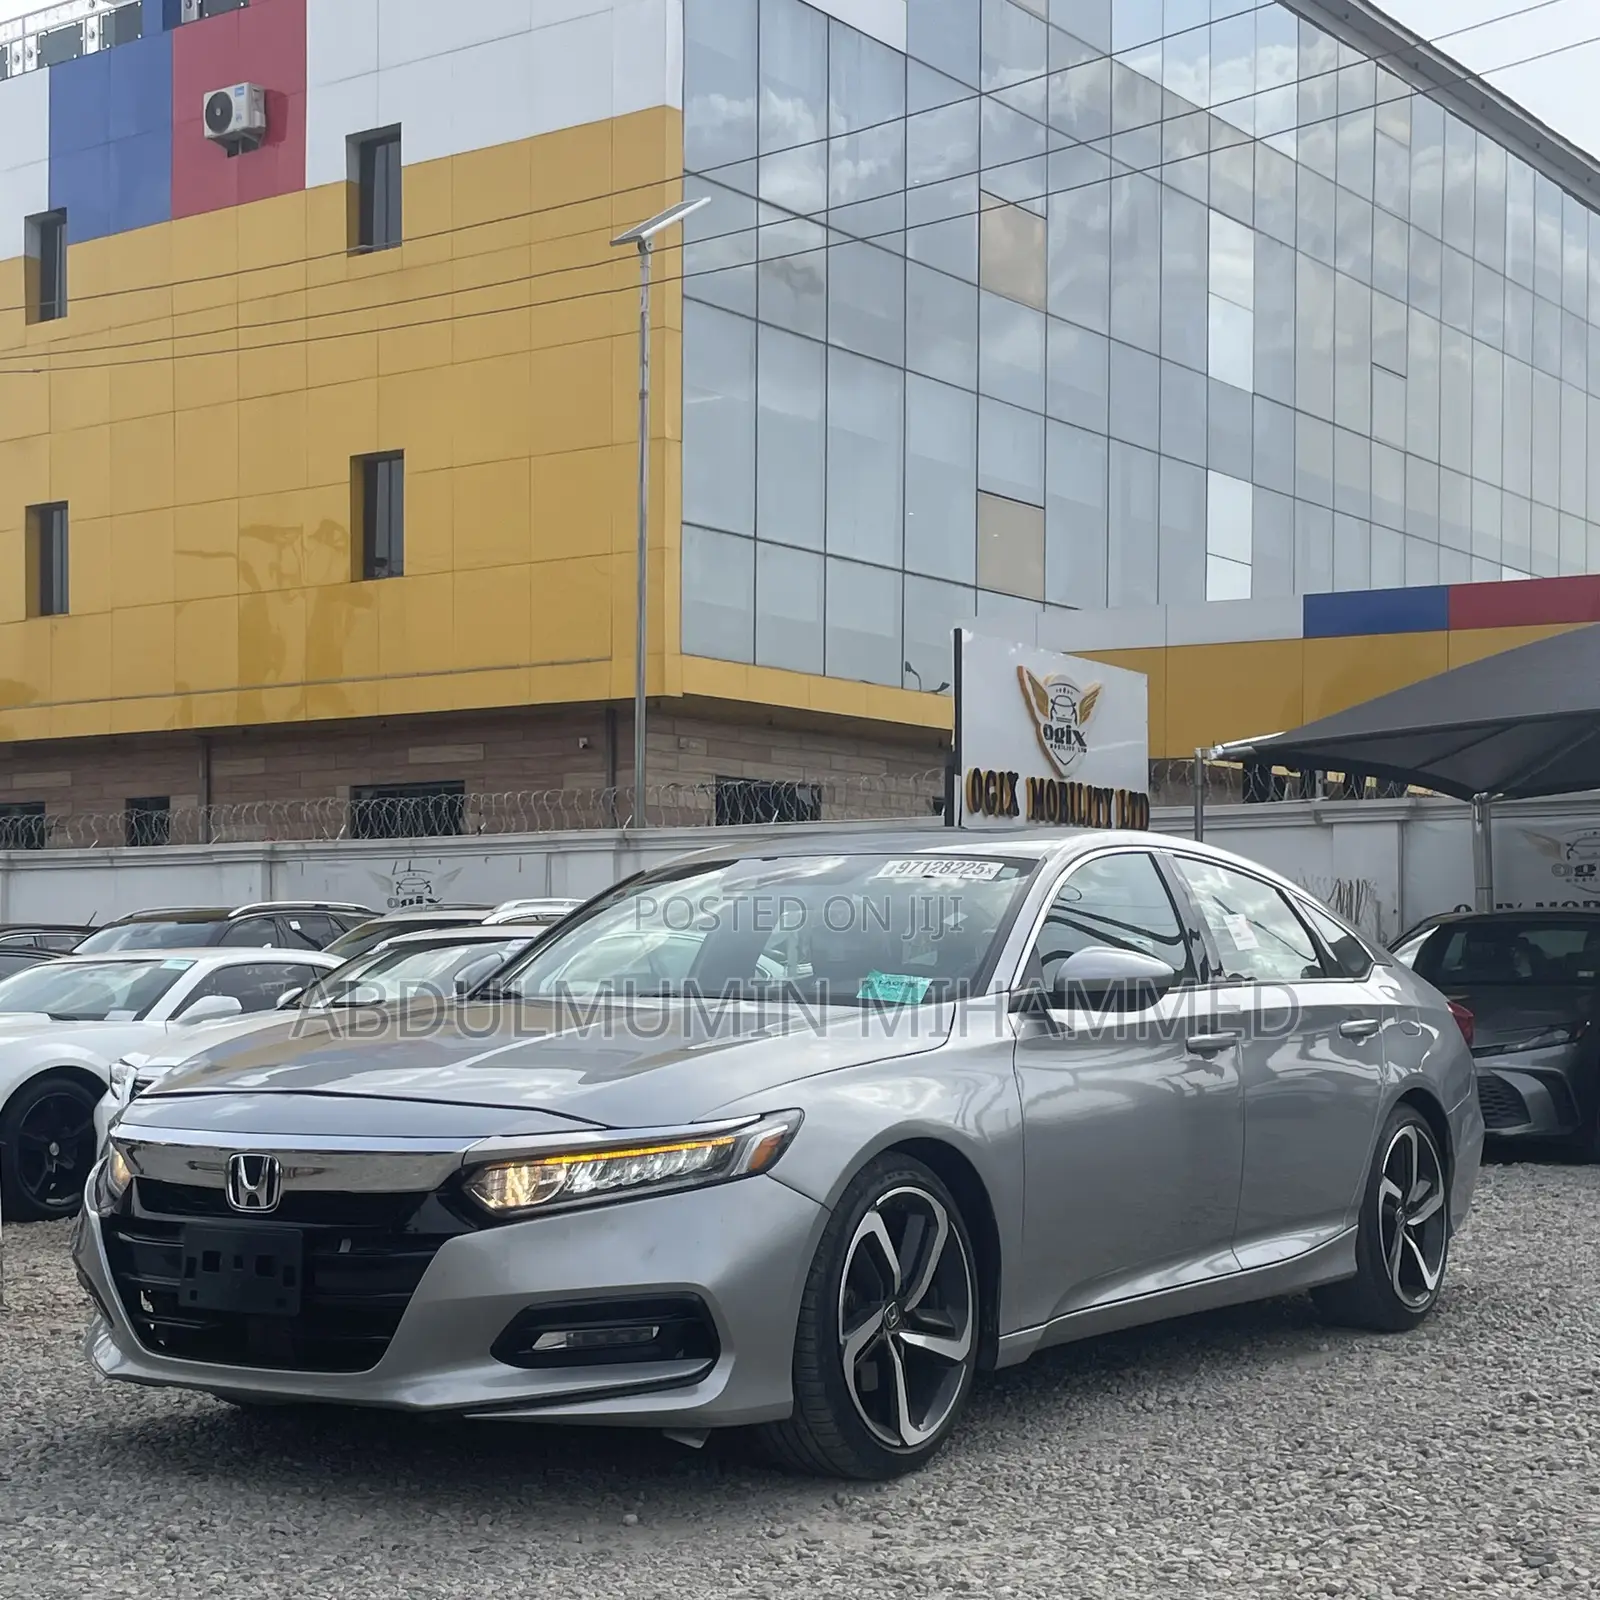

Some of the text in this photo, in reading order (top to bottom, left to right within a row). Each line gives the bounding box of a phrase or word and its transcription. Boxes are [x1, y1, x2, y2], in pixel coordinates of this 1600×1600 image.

[1043, 724, 1087, 747] Ogix
[966, 768, 1150, 831] OGIX MOBILITY LTD
